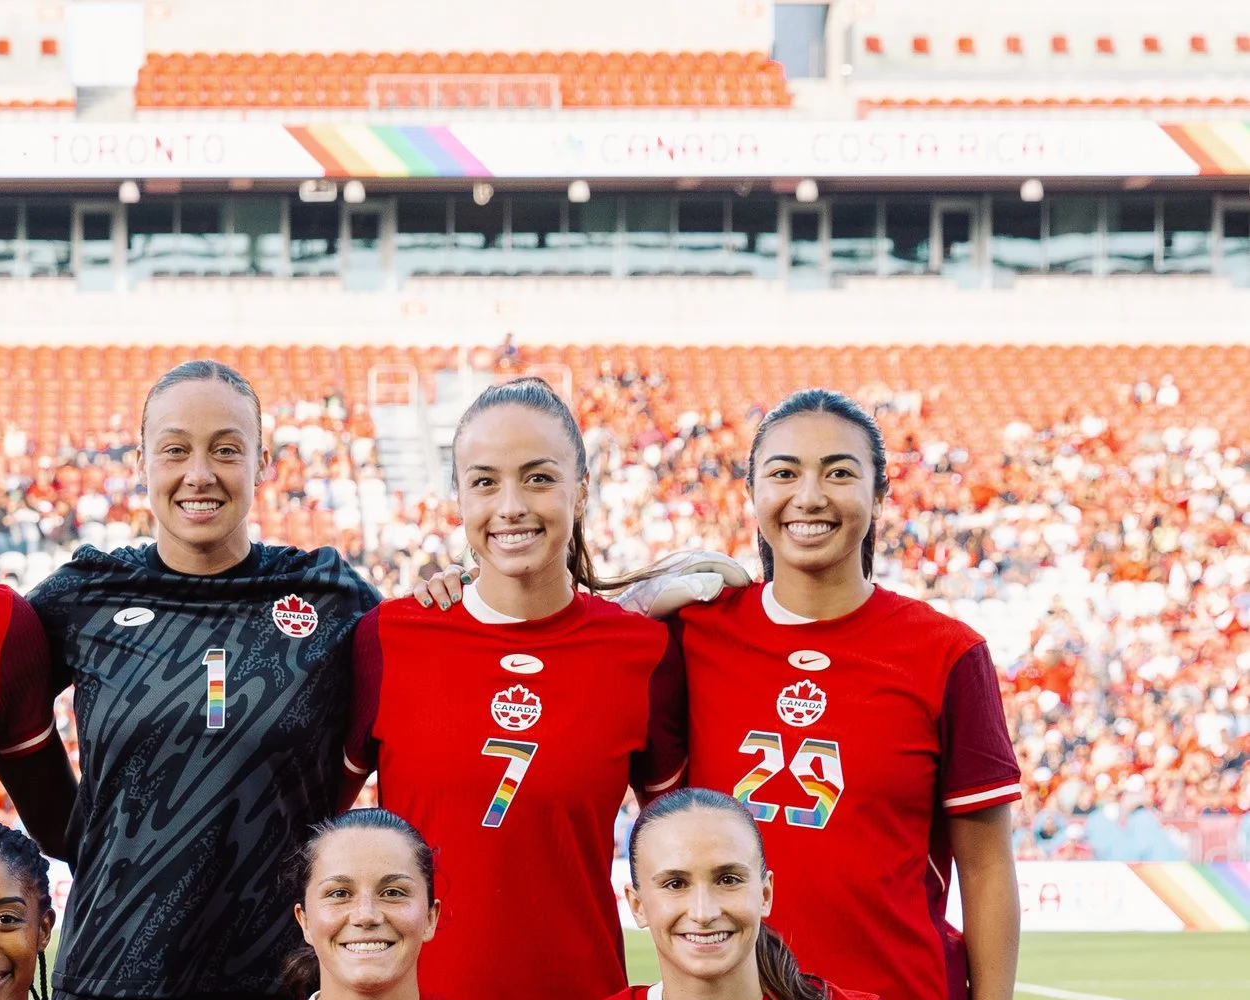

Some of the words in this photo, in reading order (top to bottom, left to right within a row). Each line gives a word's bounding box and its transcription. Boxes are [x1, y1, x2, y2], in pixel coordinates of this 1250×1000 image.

[50, 135, 227, 165] TORONTO
[599, 133, 761, 164] CANADA
[810, 133, 940, 164] COSTA
[957, 133, 1047, 164] RICA
[274, 611, 316, 622] CANADA
[202, 649, 226, 729] 1
[779, 698, 823, 710] CANADA
[493, 703, 539, 715] CANADA
[481, 738, 539, 828] 7
[733, 729, 845, 830] 29
